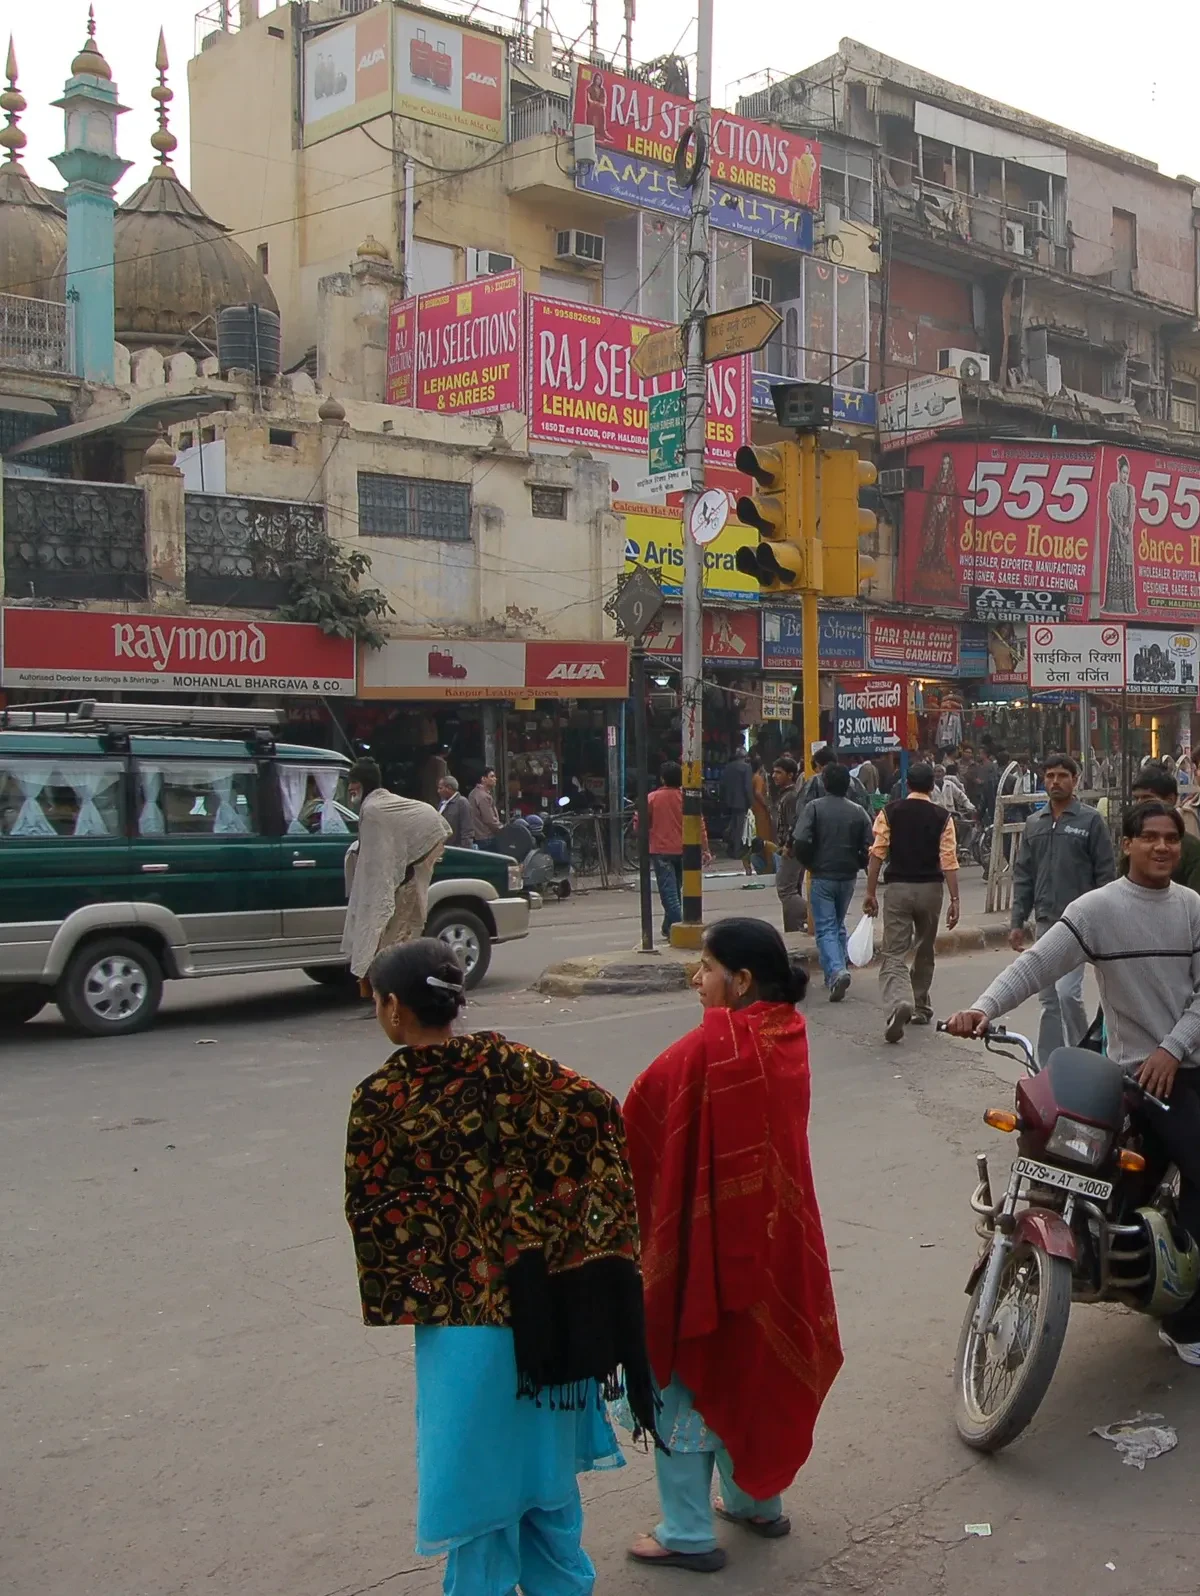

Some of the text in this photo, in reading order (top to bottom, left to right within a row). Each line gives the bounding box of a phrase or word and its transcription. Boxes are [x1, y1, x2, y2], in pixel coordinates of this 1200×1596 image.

[465, 71, 497, 88] ALFA
[611, 84, 654, 132] RAJ
[730, 166, 777, 195] SAREES
[418, 308, 517, 370] RAJ SELECTIONS
[540, 330, 588, 391] RAJ
[424, 371, 479, 395] LEHANGA
[481, 363, 510, 381] SUIT
[449, 385, 495, 408] SAREES
[542, 394, 619, 424] LEHANGA
[963, 462, 1094, 523] 555
[613, 501, 665, 515] Calcutta Hat
[960, 519, 1089, 560] Saree House
[1139, 528, 1184, 564] Saree
[1001, 558, 1034, 572] EXPORTER,
[1036, 561, 1086, 576] MANUFACTURER
[1023, 574, 1038, 586] SUIT
[1040, 576, 1045, 587] &
[1046, 577, 1078, 590] LEHENGA
[977, 589, 1052, 603] A TO
[824, 616, 864, 639] Stores
[875, 627, 900, 644] HARI
[111, 622, 266, 671] Raymond
[905, 650, 952, 663] GARMENTS
[1089, 649, 1121, 663] रिक्शा
[546, 664, 605, 680] ALFA
[1046, 668, 1109, 682] ठेला वर्जित
[173, 676, 342, 691] MOHANLAL BHARGAVA & CO.
[1160, 686, 1179, 694] HOUSE
[445, 688, 559, 698] Kanpur Leather Stores
[1057, 1173, 1074, 1187] AT
